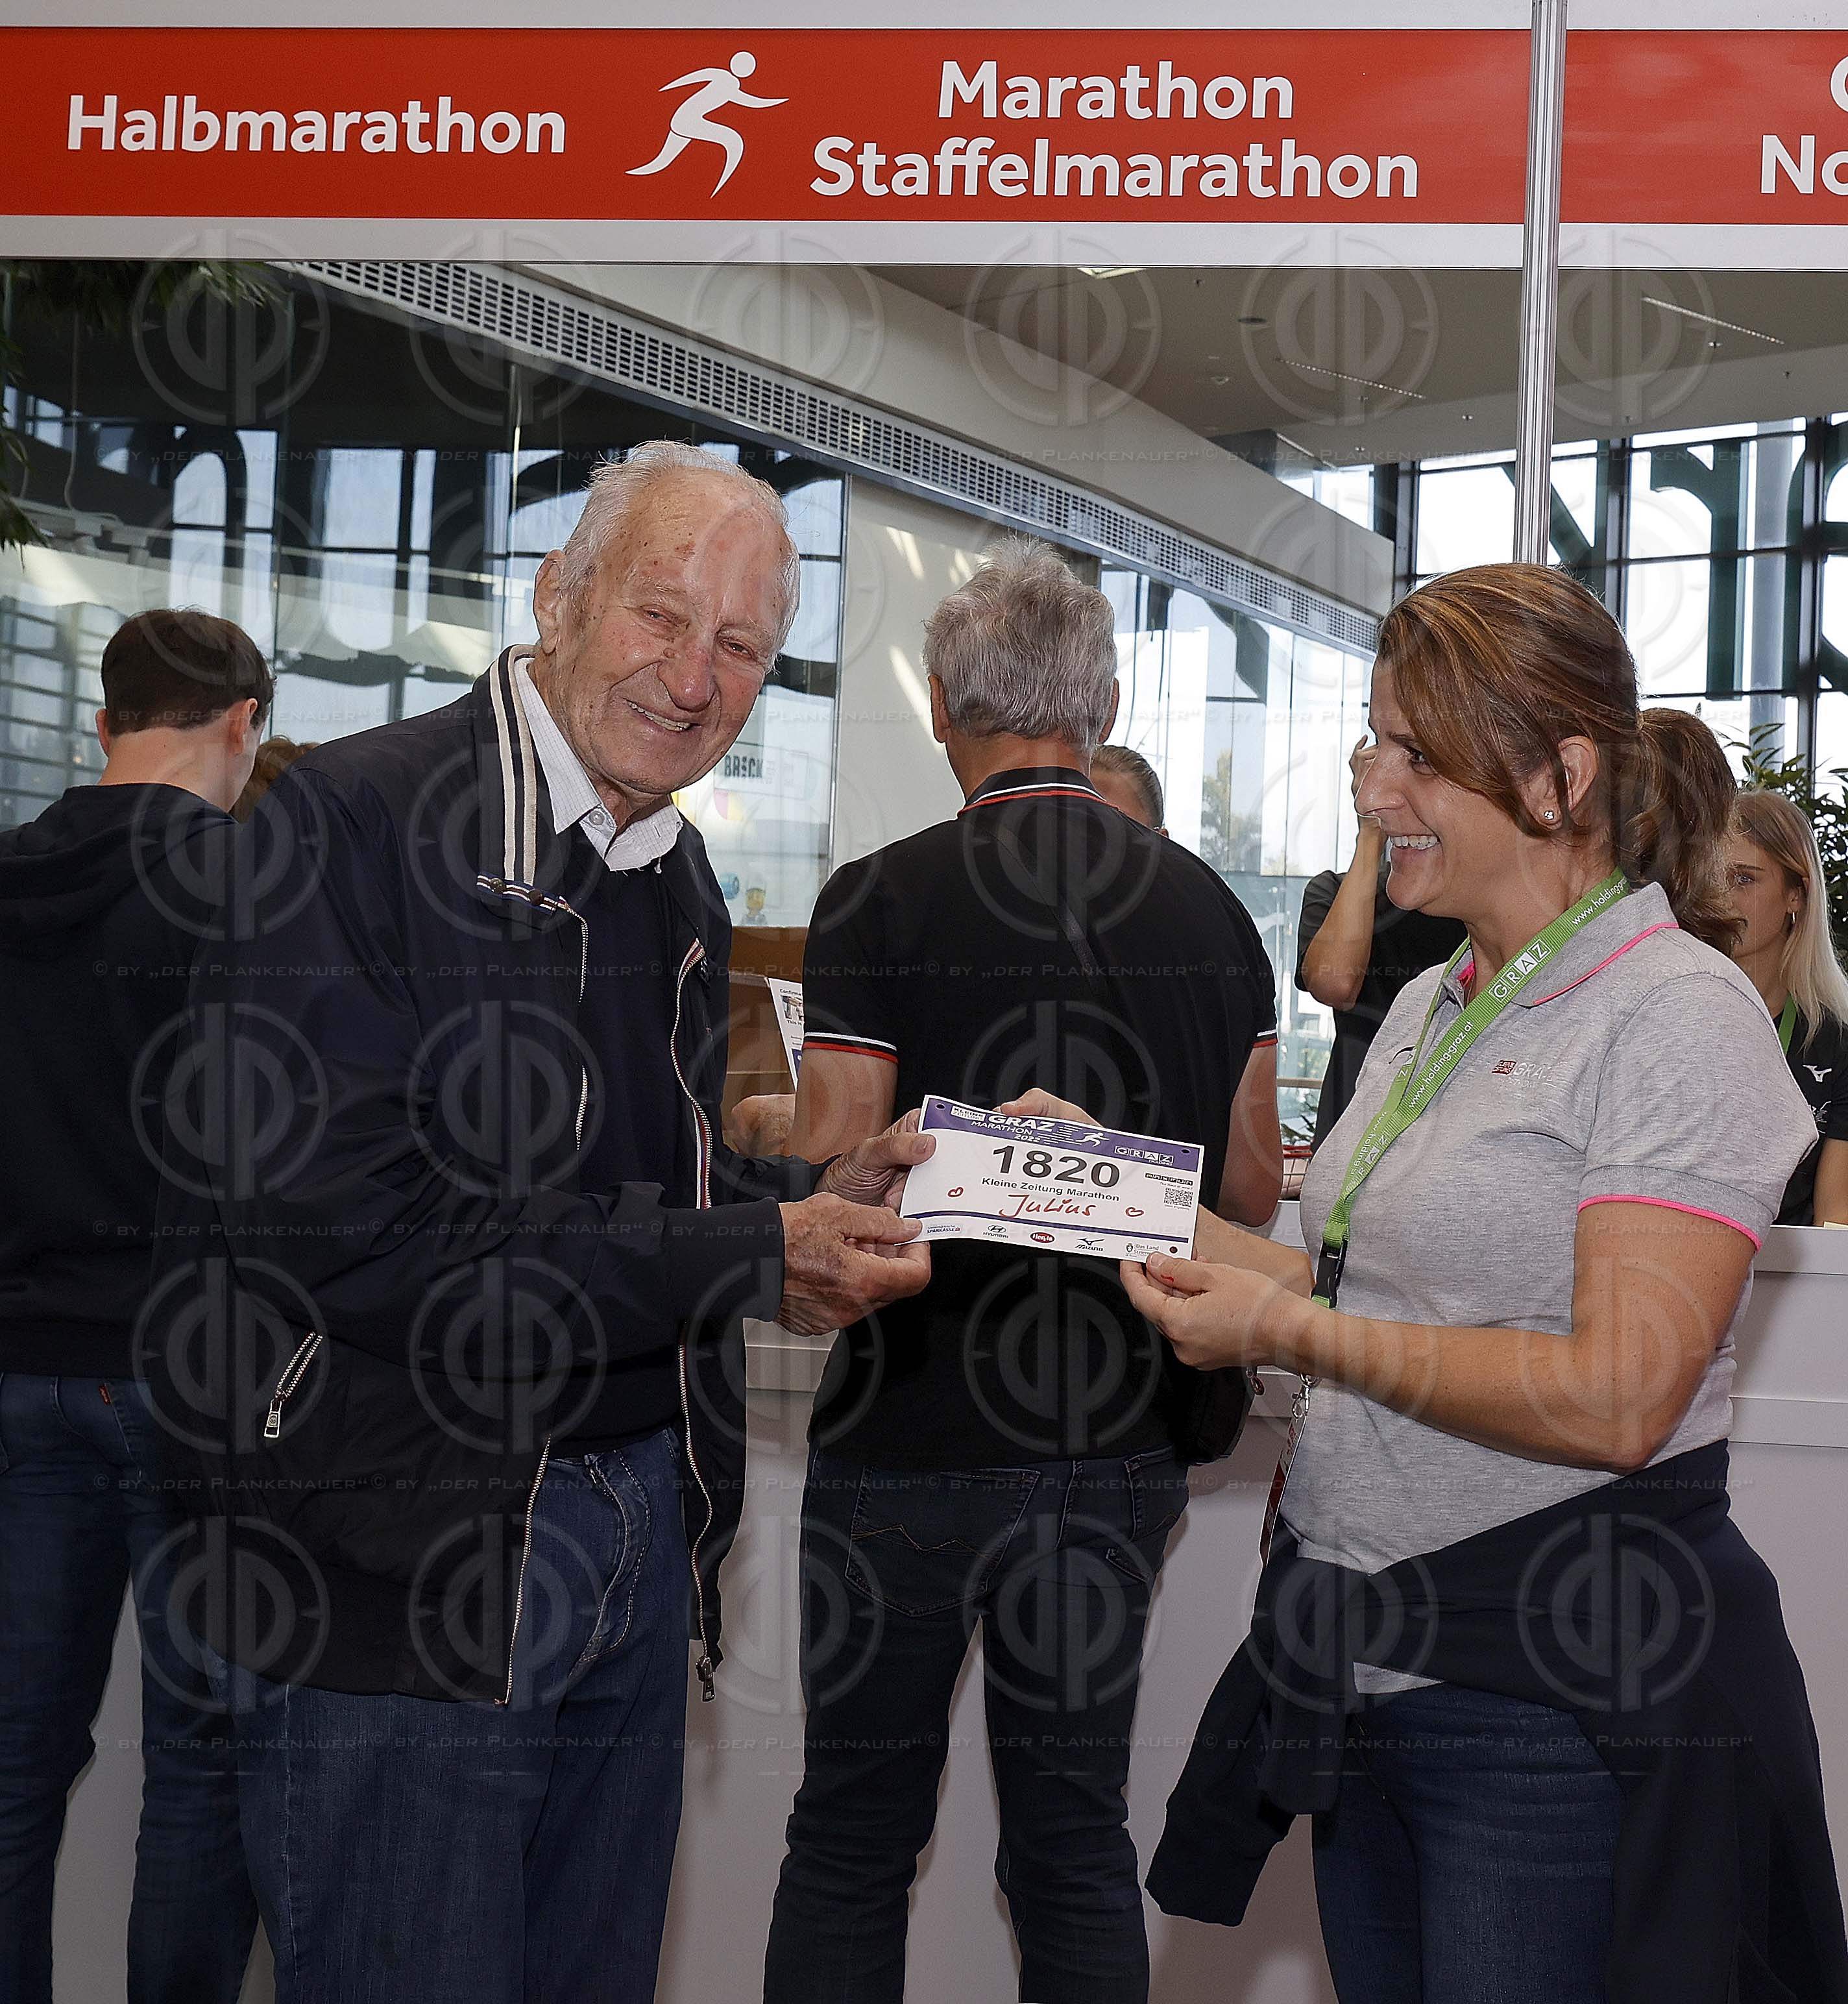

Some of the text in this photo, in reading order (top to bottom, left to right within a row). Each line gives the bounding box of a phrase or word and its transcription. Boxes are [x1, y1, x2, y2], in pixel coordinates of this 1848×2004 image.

[938, 60, 1294, 121] Marathon
[66, 94, 565, 154] Halbmarathon
[810, 136, 1419, 200] Staffelmarathon
[1492, 940, 1550, 1001] GRAZ
[1408, 1021, 1474, 1108] www.holding-graz.at
[970, 1121, 1034, 1135] MARATHON
[988, 1114, 1057, 1132] GRAZ
[1014, 1133, 1041, 1143] 2022
[991, 1145, 1121, 1189] 1820
[1115, 1145, 1173, 1164] GRAZ
[982, 1177, 1119, 1202] Kleine Zeitung Marathon
